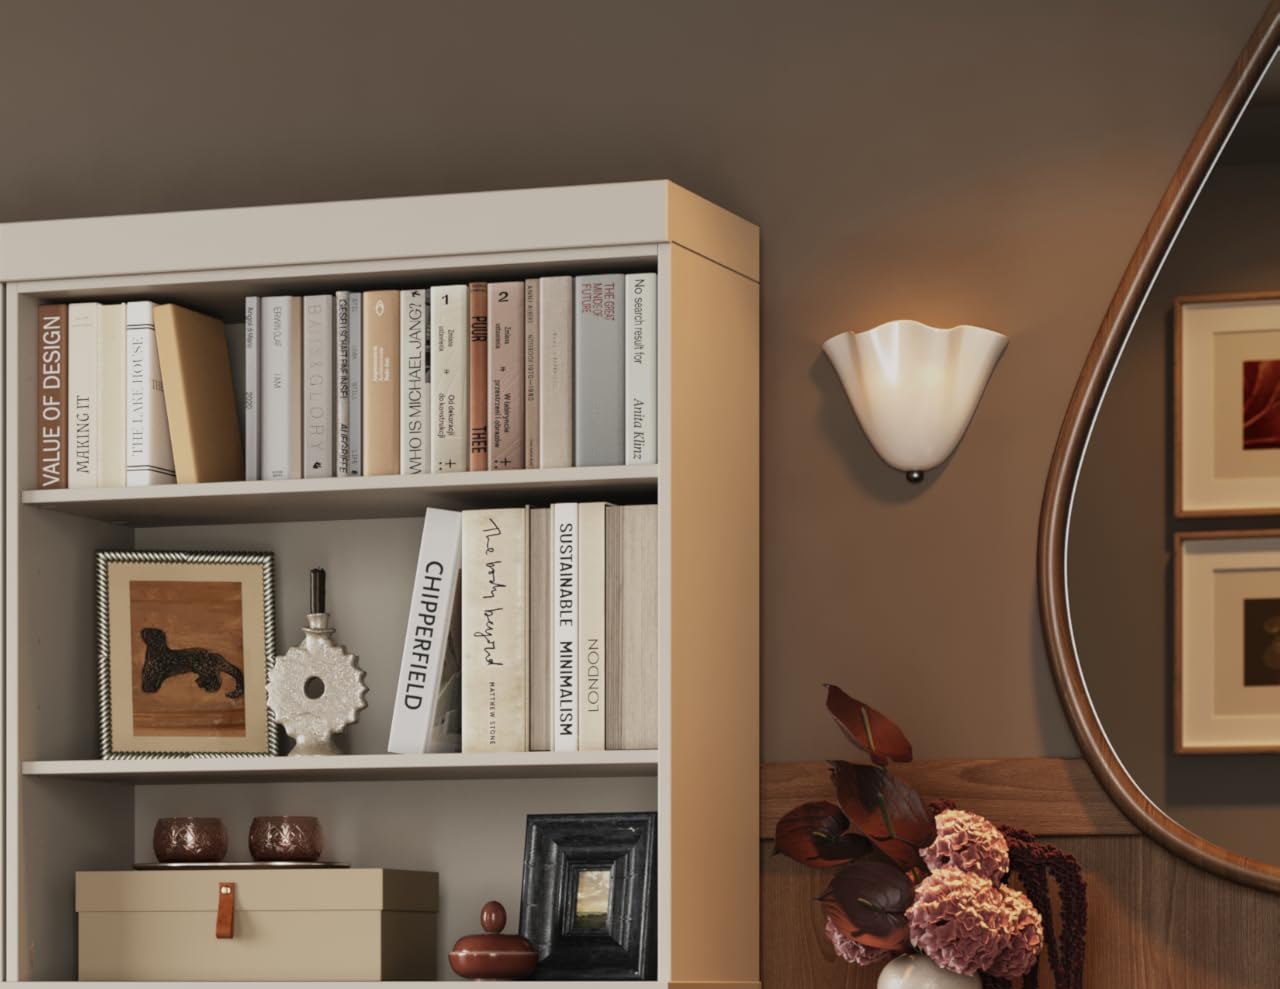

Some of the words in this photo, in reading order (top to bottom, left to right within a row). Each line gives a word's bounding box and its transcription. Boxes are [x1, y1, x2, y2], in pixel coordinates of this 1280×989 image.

[582, 283, 591, 313] FUTURE
[604, 284, 615, 300] THE
[634, 279, 645, 295] No
[409, 303, 422, 349] JANG?
[604, 301, 615, 321] GREAT
[634, 298, 645, 326] search
[472, 316, 487, 342] PUUR
[634, 328, 645, 350] result
[43, 316, 60, 389] DESIGN
[634, 352, 645, 364] for
[409, 352, 422, 417] MICHAEL
[43, 396, 60, 420] OF
[76, 395, 89, 410] IT
[633, 398, 645, 429] Anita
[409, 421, 422, 434] IS
[472, 427, 487, 454] THEE
[43, 427, 60, 487] VALUE
[76, 413, 89, 474] MAKING
[409, 437, 422, 475] WHO
[633, 432, 645, 460] Klinz
[483, 518, 501, 556] The
[483, 560, 506, 599] body
[560, 523, 573, 627] SUSTAINABLE
[404, 560, 443, 711] CHIPPERFIELD
[474, 607, 504, 666] beyond
[560, 641, 573, 736] MINIMALISM
[588, 639, 600, 712] LONDON
